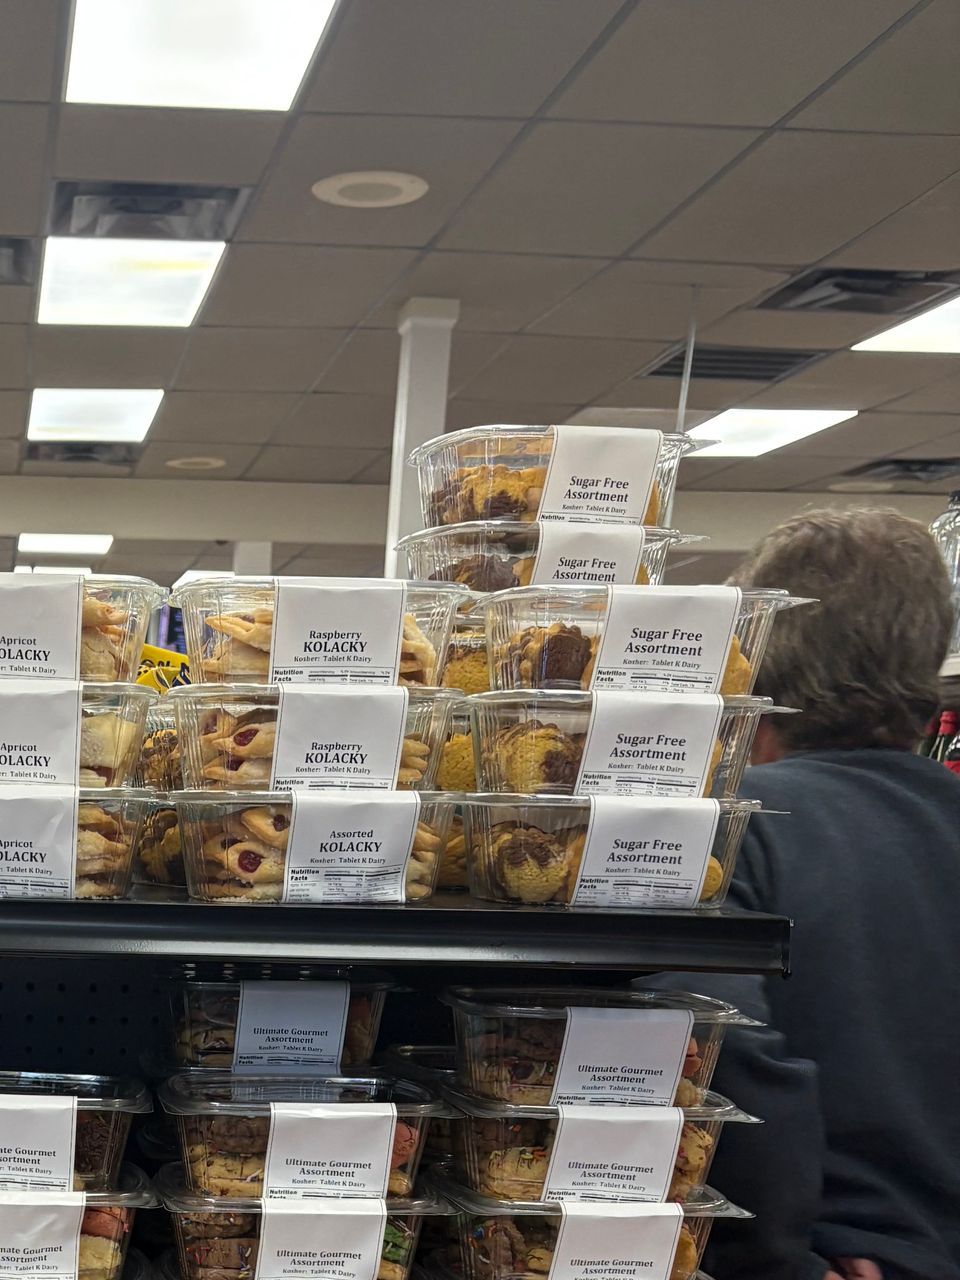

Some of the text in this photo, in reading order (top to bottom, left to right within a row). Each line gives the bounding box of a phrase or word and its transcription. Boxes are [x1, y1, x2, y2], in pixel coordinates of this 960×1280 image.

[570, 476, 629, 489] Sugar Free
[564, 489, 628, 502] Assortment
[558, 557, 616, 569] Sugar Free
[552, 570, 615, 582] Assortment
[310, 630, 361, 641] Raspberry
[631, 628, 702, 642] Sugar Free
[0, 636, 36, 646] Apricot
[304, 641, 367, 652] KOLACKY
[624, 642, 702, 656] Assortment
[616, 734, 686, 747] Sugar Free
[1, 743, 37, 753] Apricot
[312, 742, 362, 752] Raspberry
[305, 753, 367, 764] KOLACKY
[610, 747, 686, 761] Assortment
[330, 830, 373, 838] Assorted
[320, 842, 382, 852] KOLACKY
[613, 839, 682, 852] Sugar Free
[607, 852, 682, 864] Assortment
[291, 1028, 328, 1036] Gourmet
[265, 1036, 313, 1044] Assortment
[578, 1065, 663, 1076] Ultimate Gourmet
[590, 1074, 645, 1084] Assortment
[15, 1148, 56, 1156] Gourmet
[286, 1158, 371, 1169] Ultimate Gourmet
[300, 1168, 354, 1177] Assortment
[277, 1250, 361, 1260] Ultimate Gourmet
